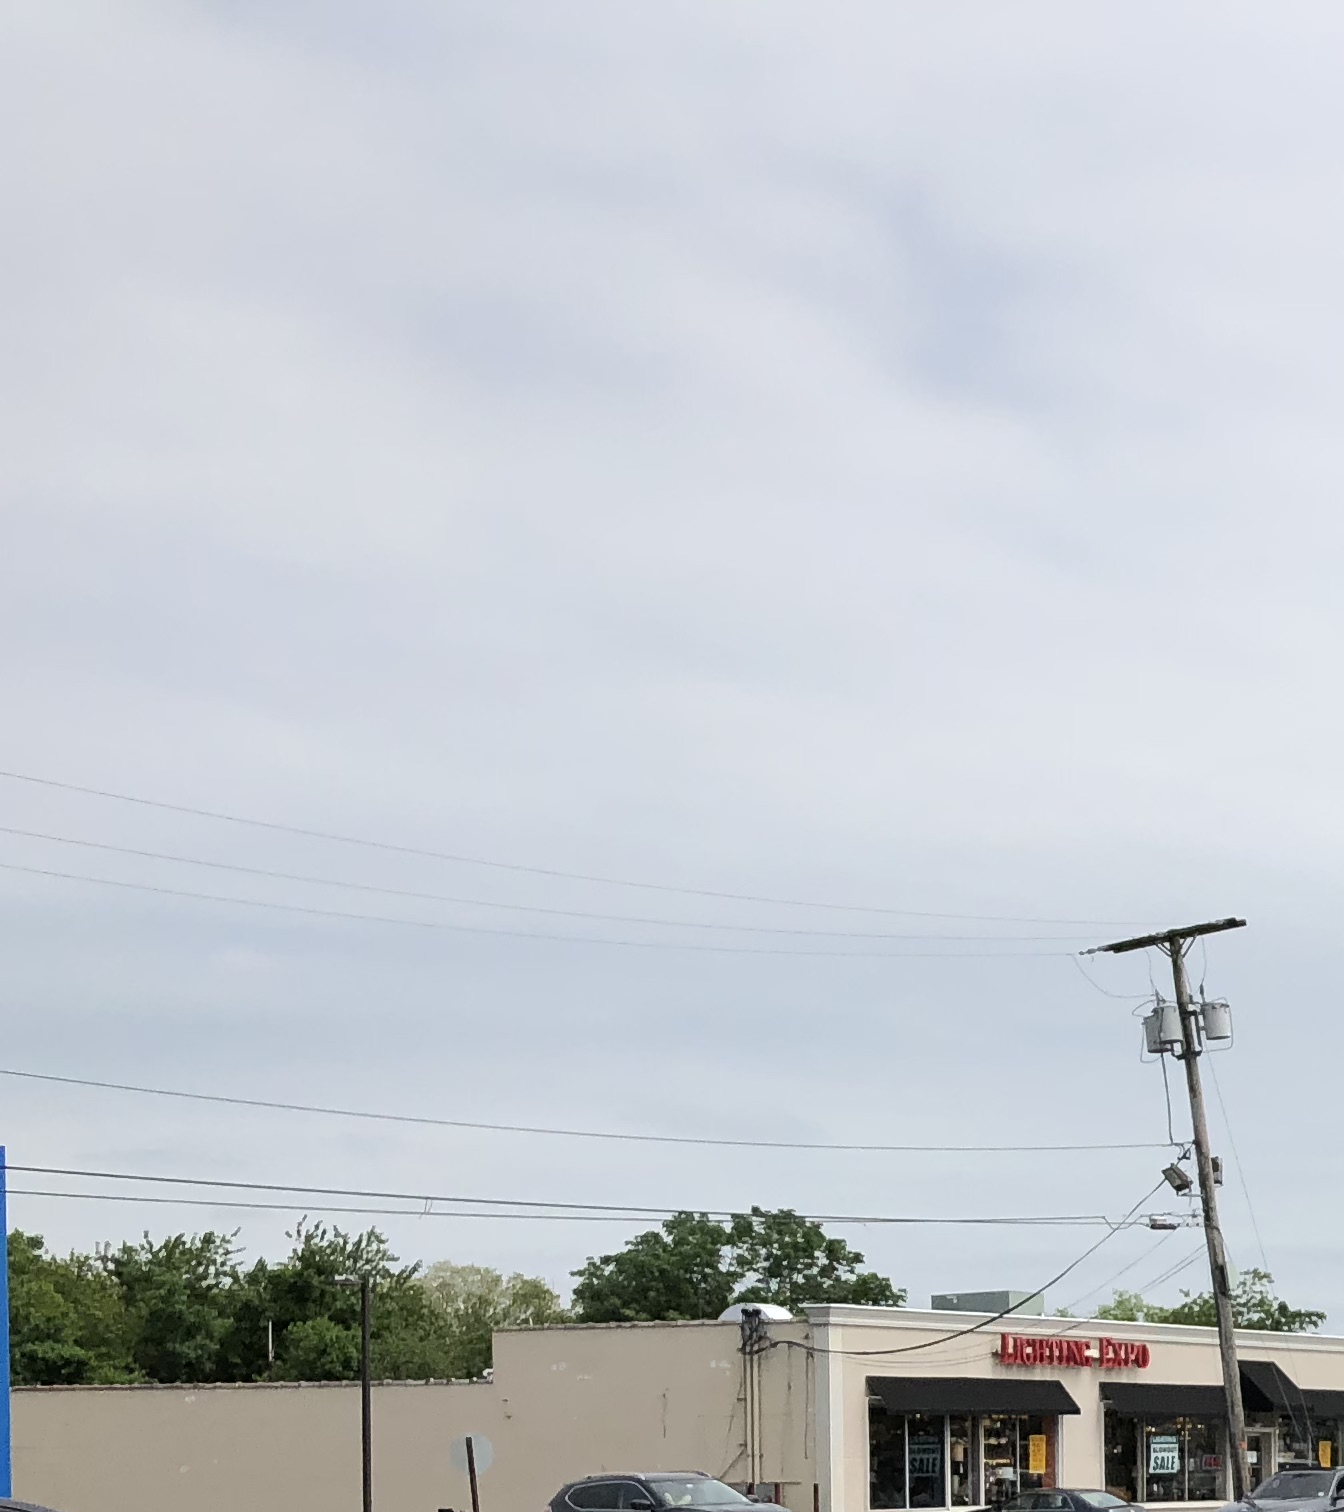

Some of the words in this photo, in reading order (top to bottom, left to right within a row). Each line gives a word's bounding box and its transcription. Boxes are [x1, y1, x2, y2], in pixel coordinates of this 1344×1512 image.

[1000, 1333, 1093, 1368] LIGHTING
[1099, 1337, 1151, 1369] EXPO
[1152, 1455, 1176, 1472] SALE
